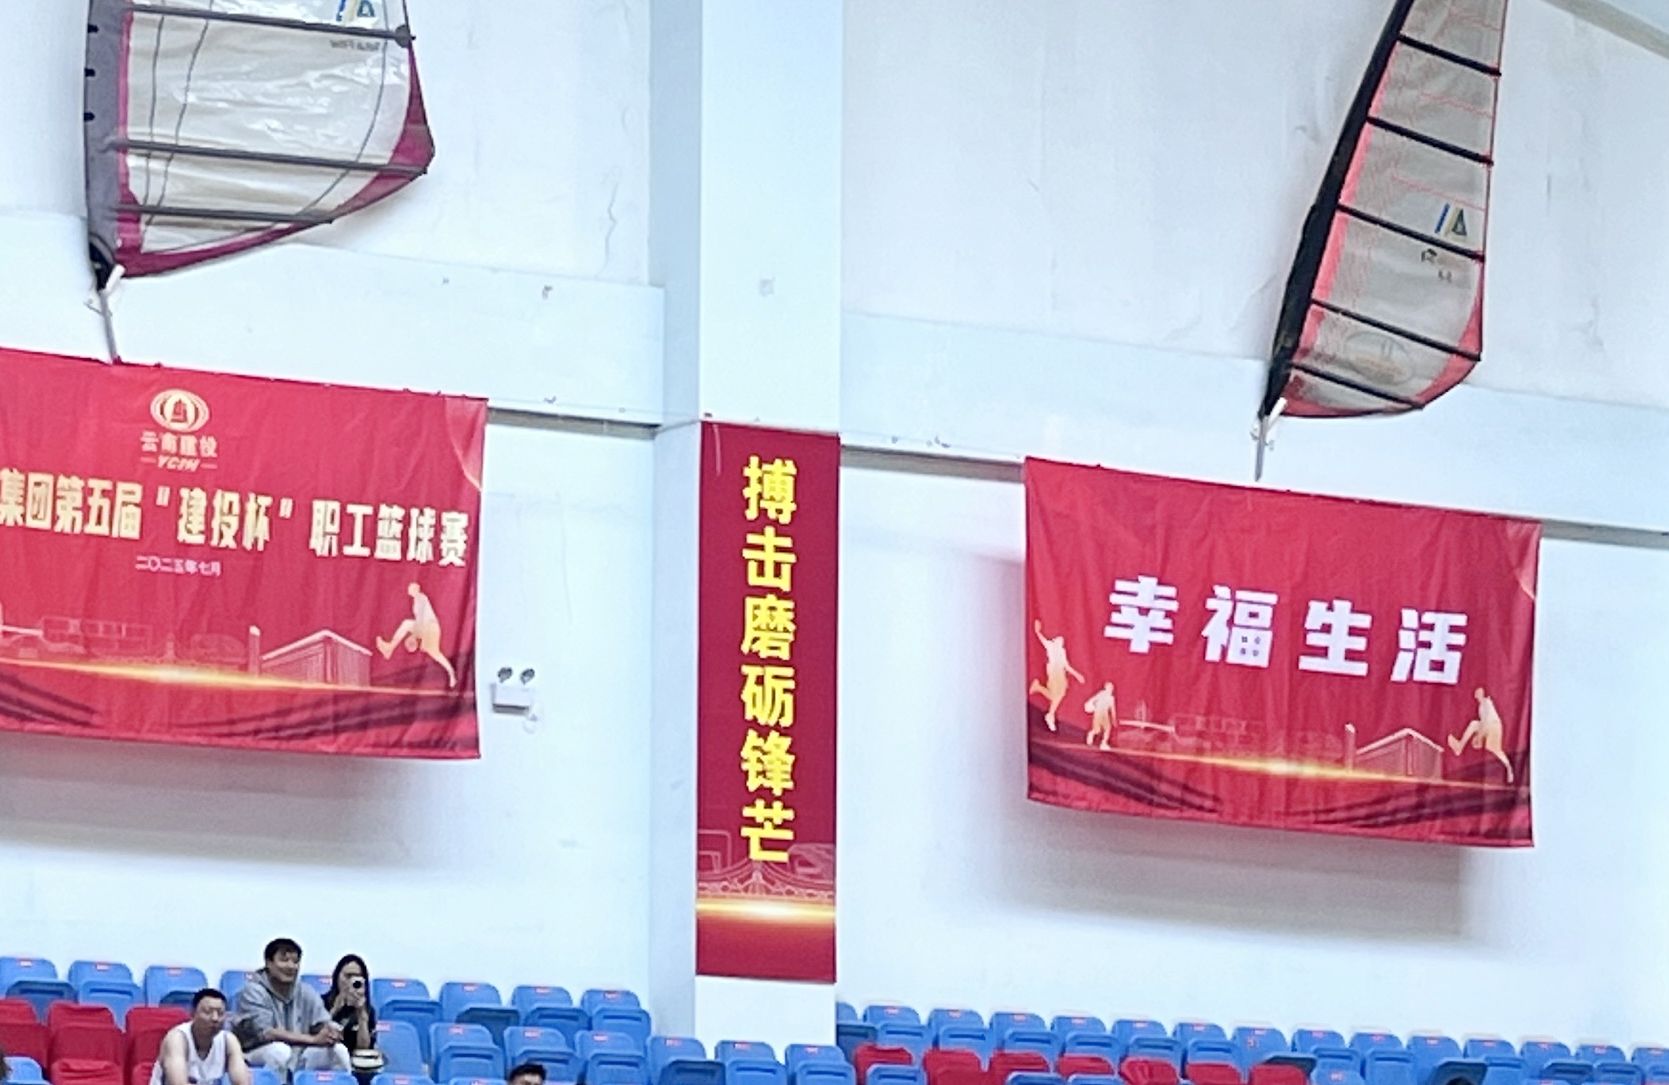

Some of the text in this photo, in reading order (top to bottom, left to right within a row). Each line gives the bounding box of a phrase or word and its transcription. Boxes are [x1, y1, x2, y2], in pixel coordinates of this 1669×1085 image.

[740, 456, 798, 864] 搏击磨砺锋芒
[1104, 575, 1469, 686] 幸福生活
